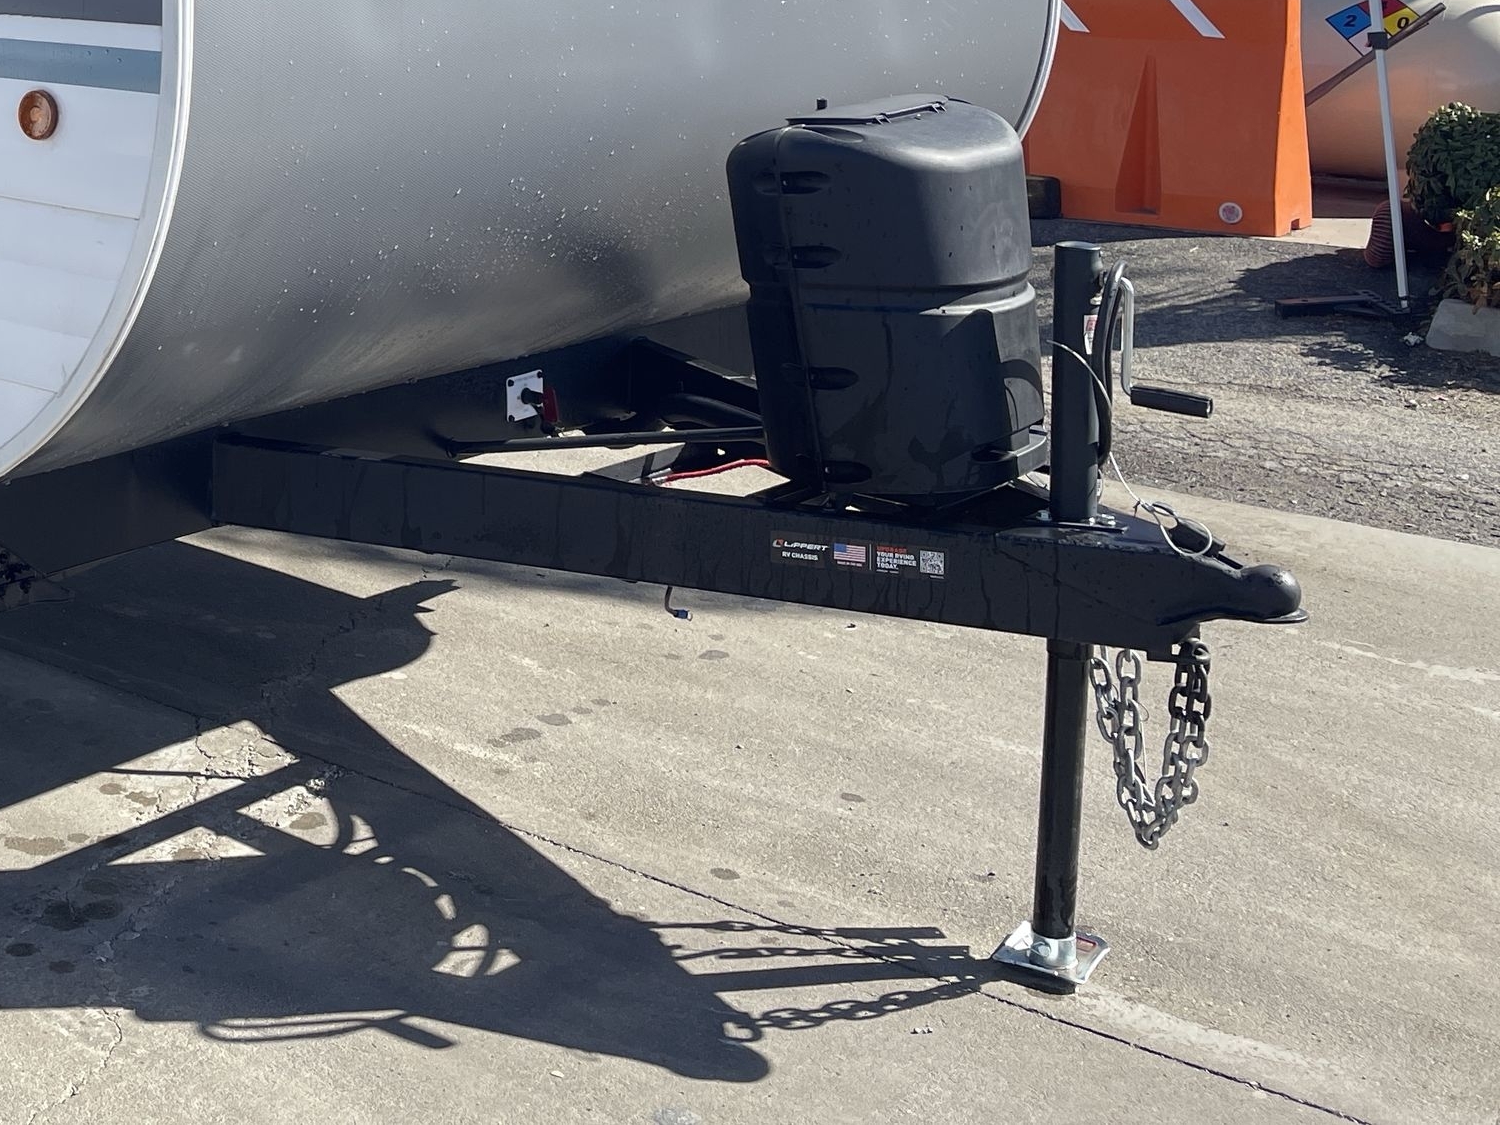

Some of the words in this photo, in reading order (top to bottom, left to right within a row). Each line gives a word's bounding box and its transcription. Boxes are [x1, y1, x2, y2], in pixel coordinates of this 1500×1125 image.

[1343, 14, 1358, 27] 2
[1397, 16, 1410, 29] 0
[784, 541, 829, 551] LIPPERT
[791, 552, 819, 561] CHASSIS
[876, 557, 917, 567] EXPERIENCE
